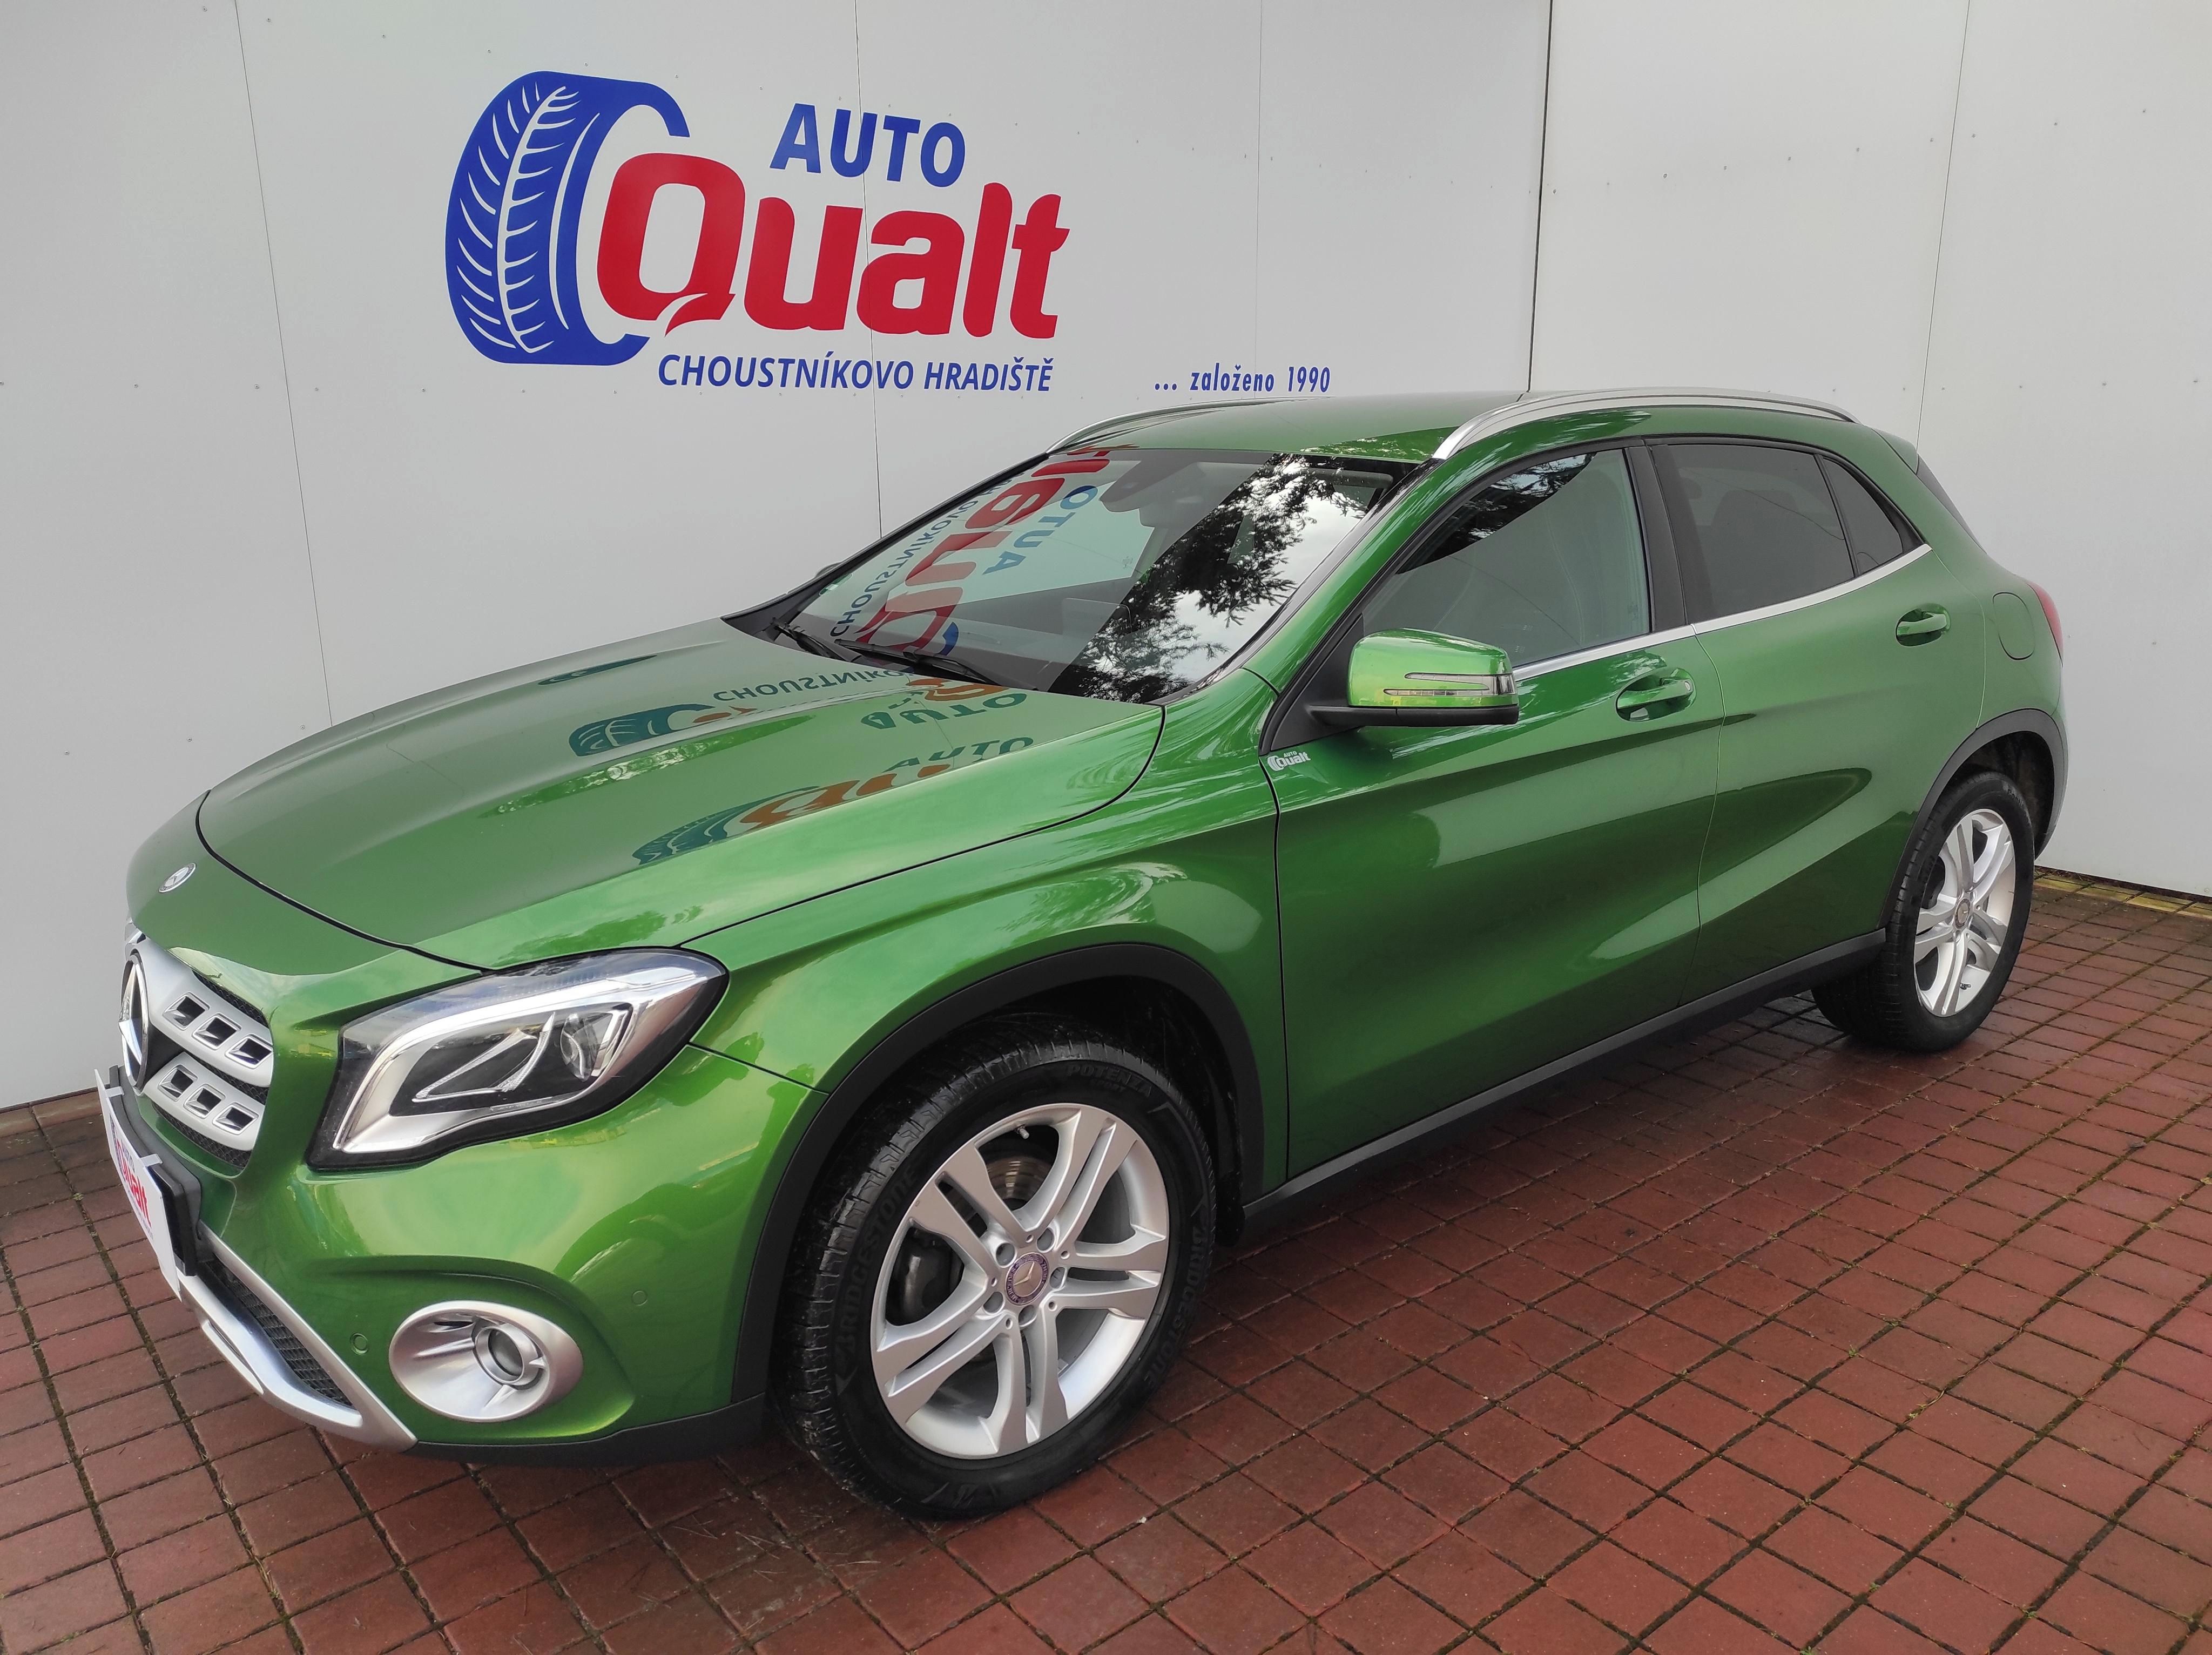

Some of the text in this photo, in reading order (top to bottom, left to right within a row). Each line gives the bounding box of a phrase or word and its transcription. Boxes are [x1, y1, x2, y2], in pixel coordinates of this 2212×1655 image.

[770, 103, 966, 188] AUTO
[596, 152, 1070, 339] Qualt
[658, 350, 1054, 391] CHOUSTNÍKOVO HRADIŠTĚ
[1189, 362, 1274, 392] založeno
[1287, 366, 1331, 393] 1990
